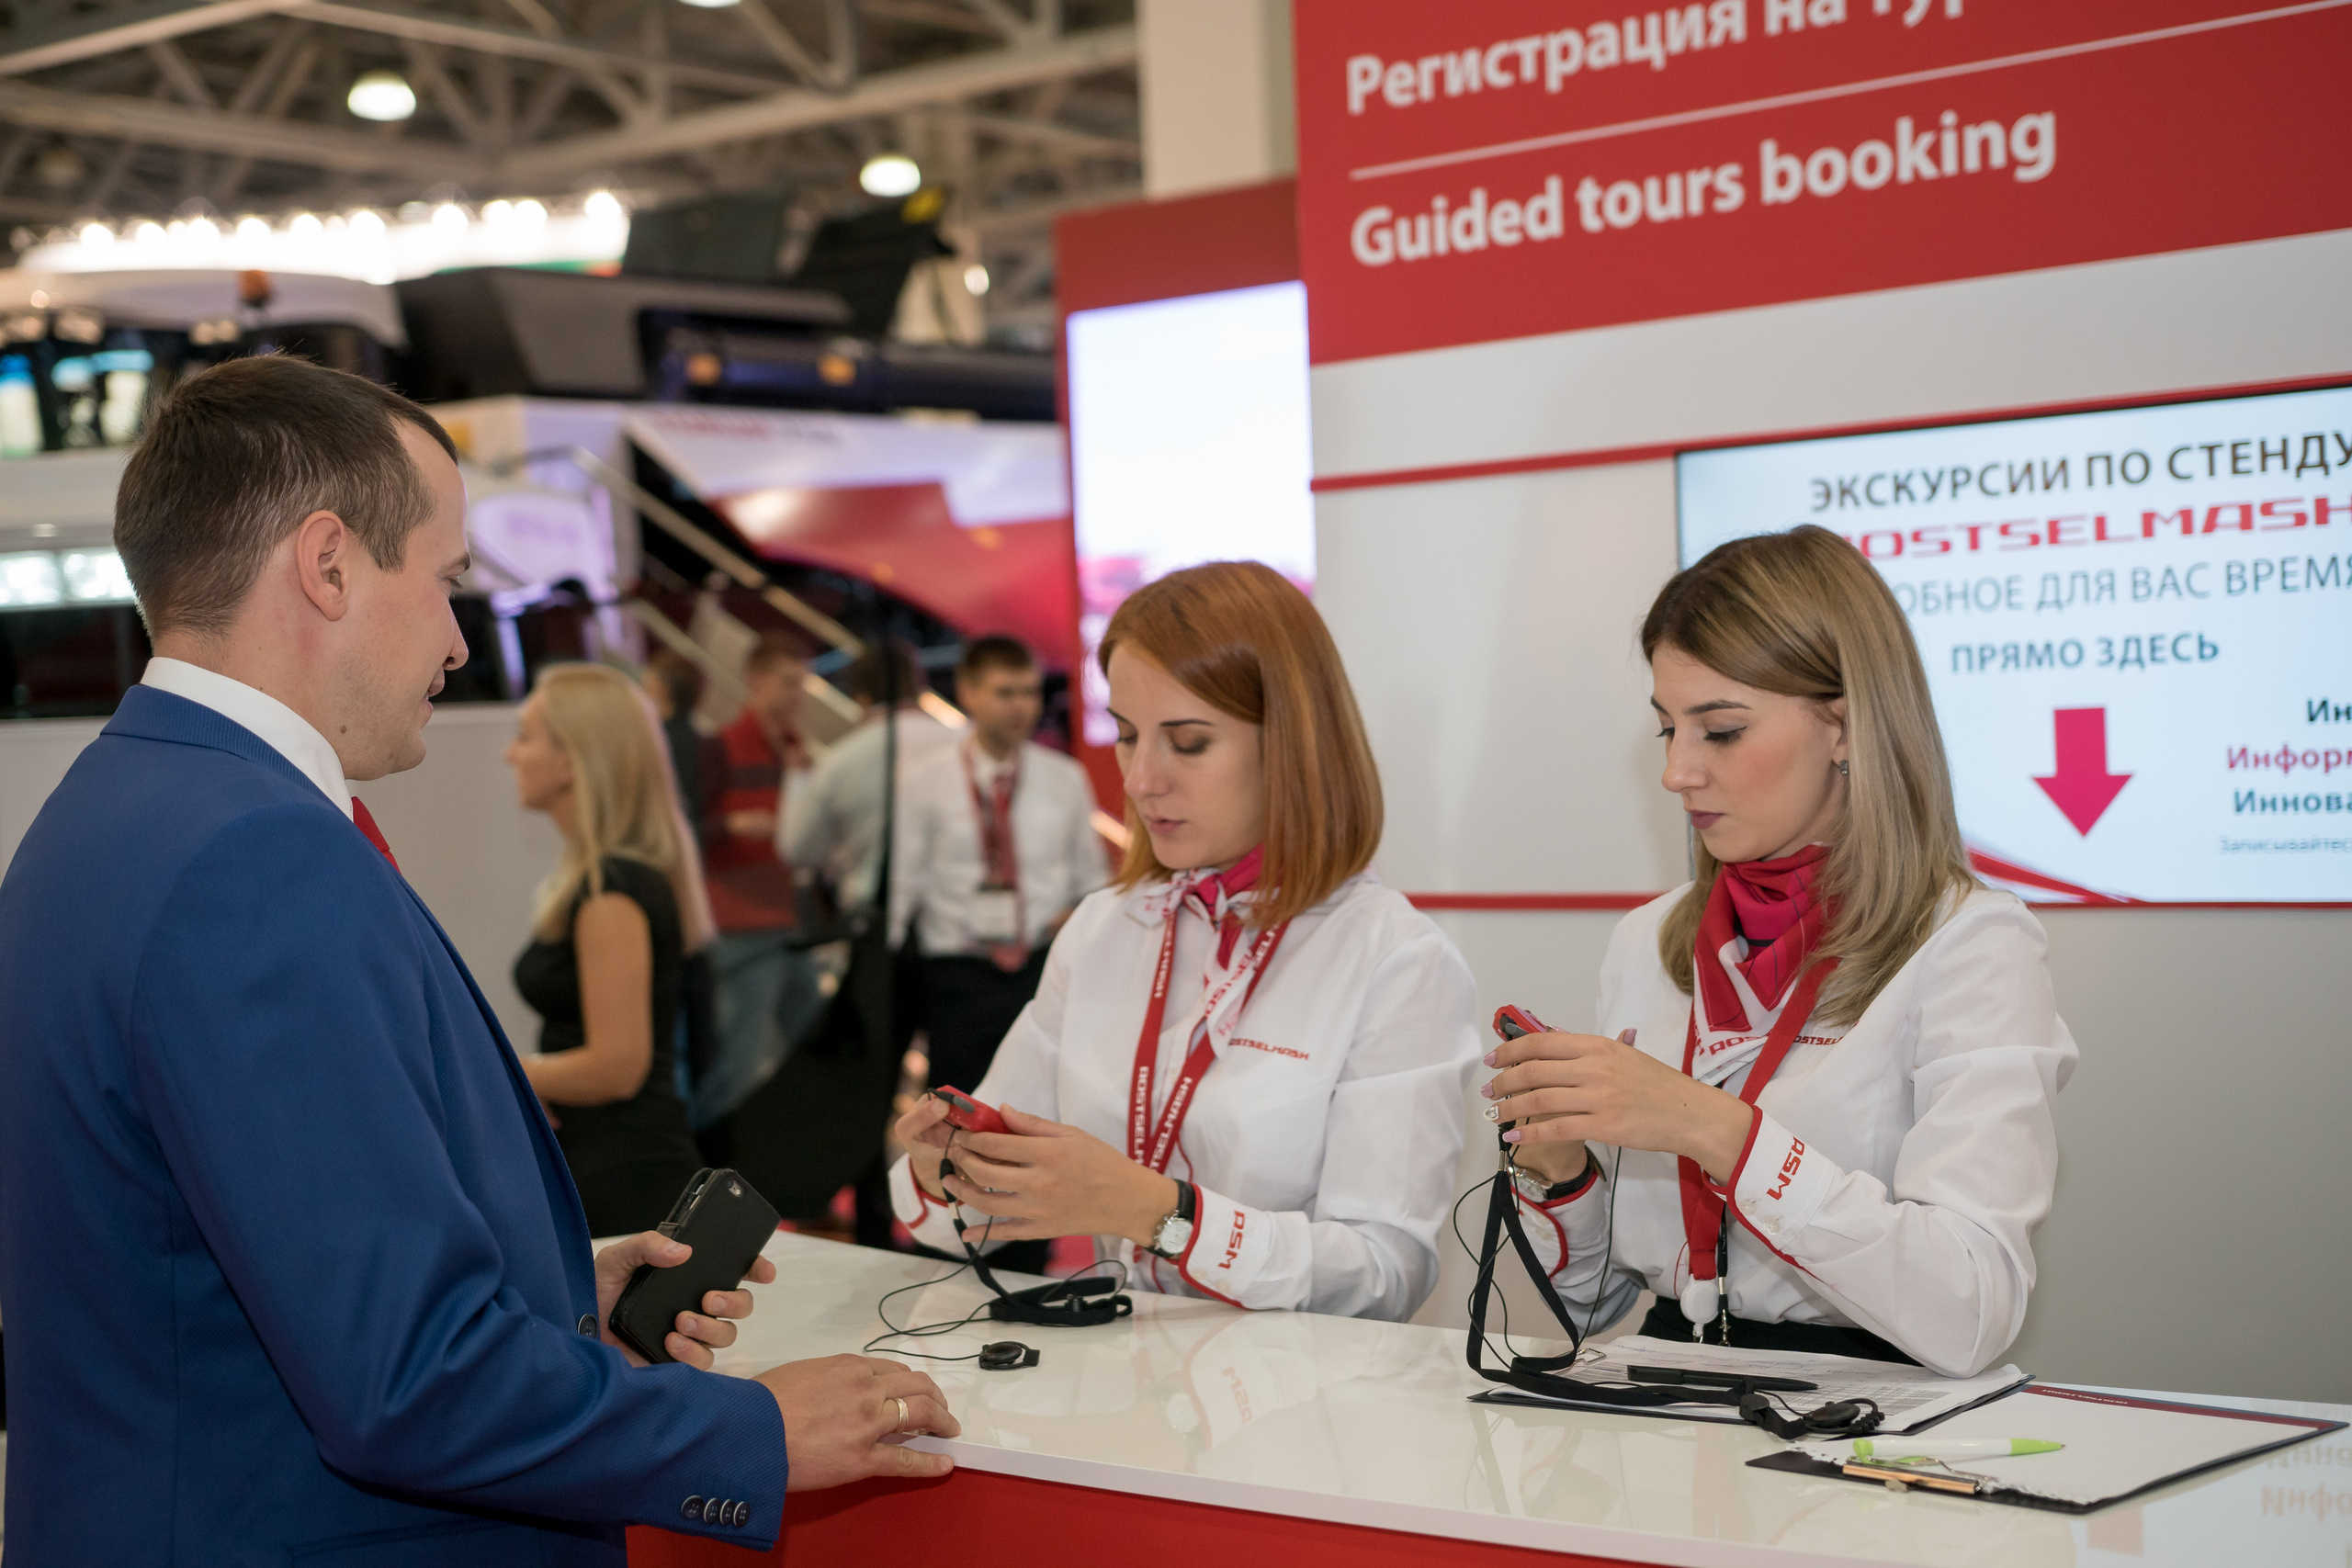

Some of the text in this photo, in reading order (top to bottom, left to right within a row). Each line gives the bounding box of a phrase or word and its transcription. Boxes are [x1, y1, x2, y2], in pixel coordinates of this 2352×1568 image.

[1346, 0, 1746, 115] Регистрация
[1351, 109, 2058, 266] Guided tours booking
[1811, 430, 2352, 512] ЭКСКУРСИИ ПО СТЕНДУ
[1843, 496, 2352, 560] OSTSELMASH
[2037, 568, 2116, 611] ДЛЯ
[2131, 561, 2211, 603] ВАС
[1951, 631, 2220, 673] ПРЯМО ЗДЕСЬ
[1148, 1076, 1193, 1173] TSELMASH
[1766, 1135, 1805, 1201] RSM
[1218, 1210, 1245, 1269] RSM
